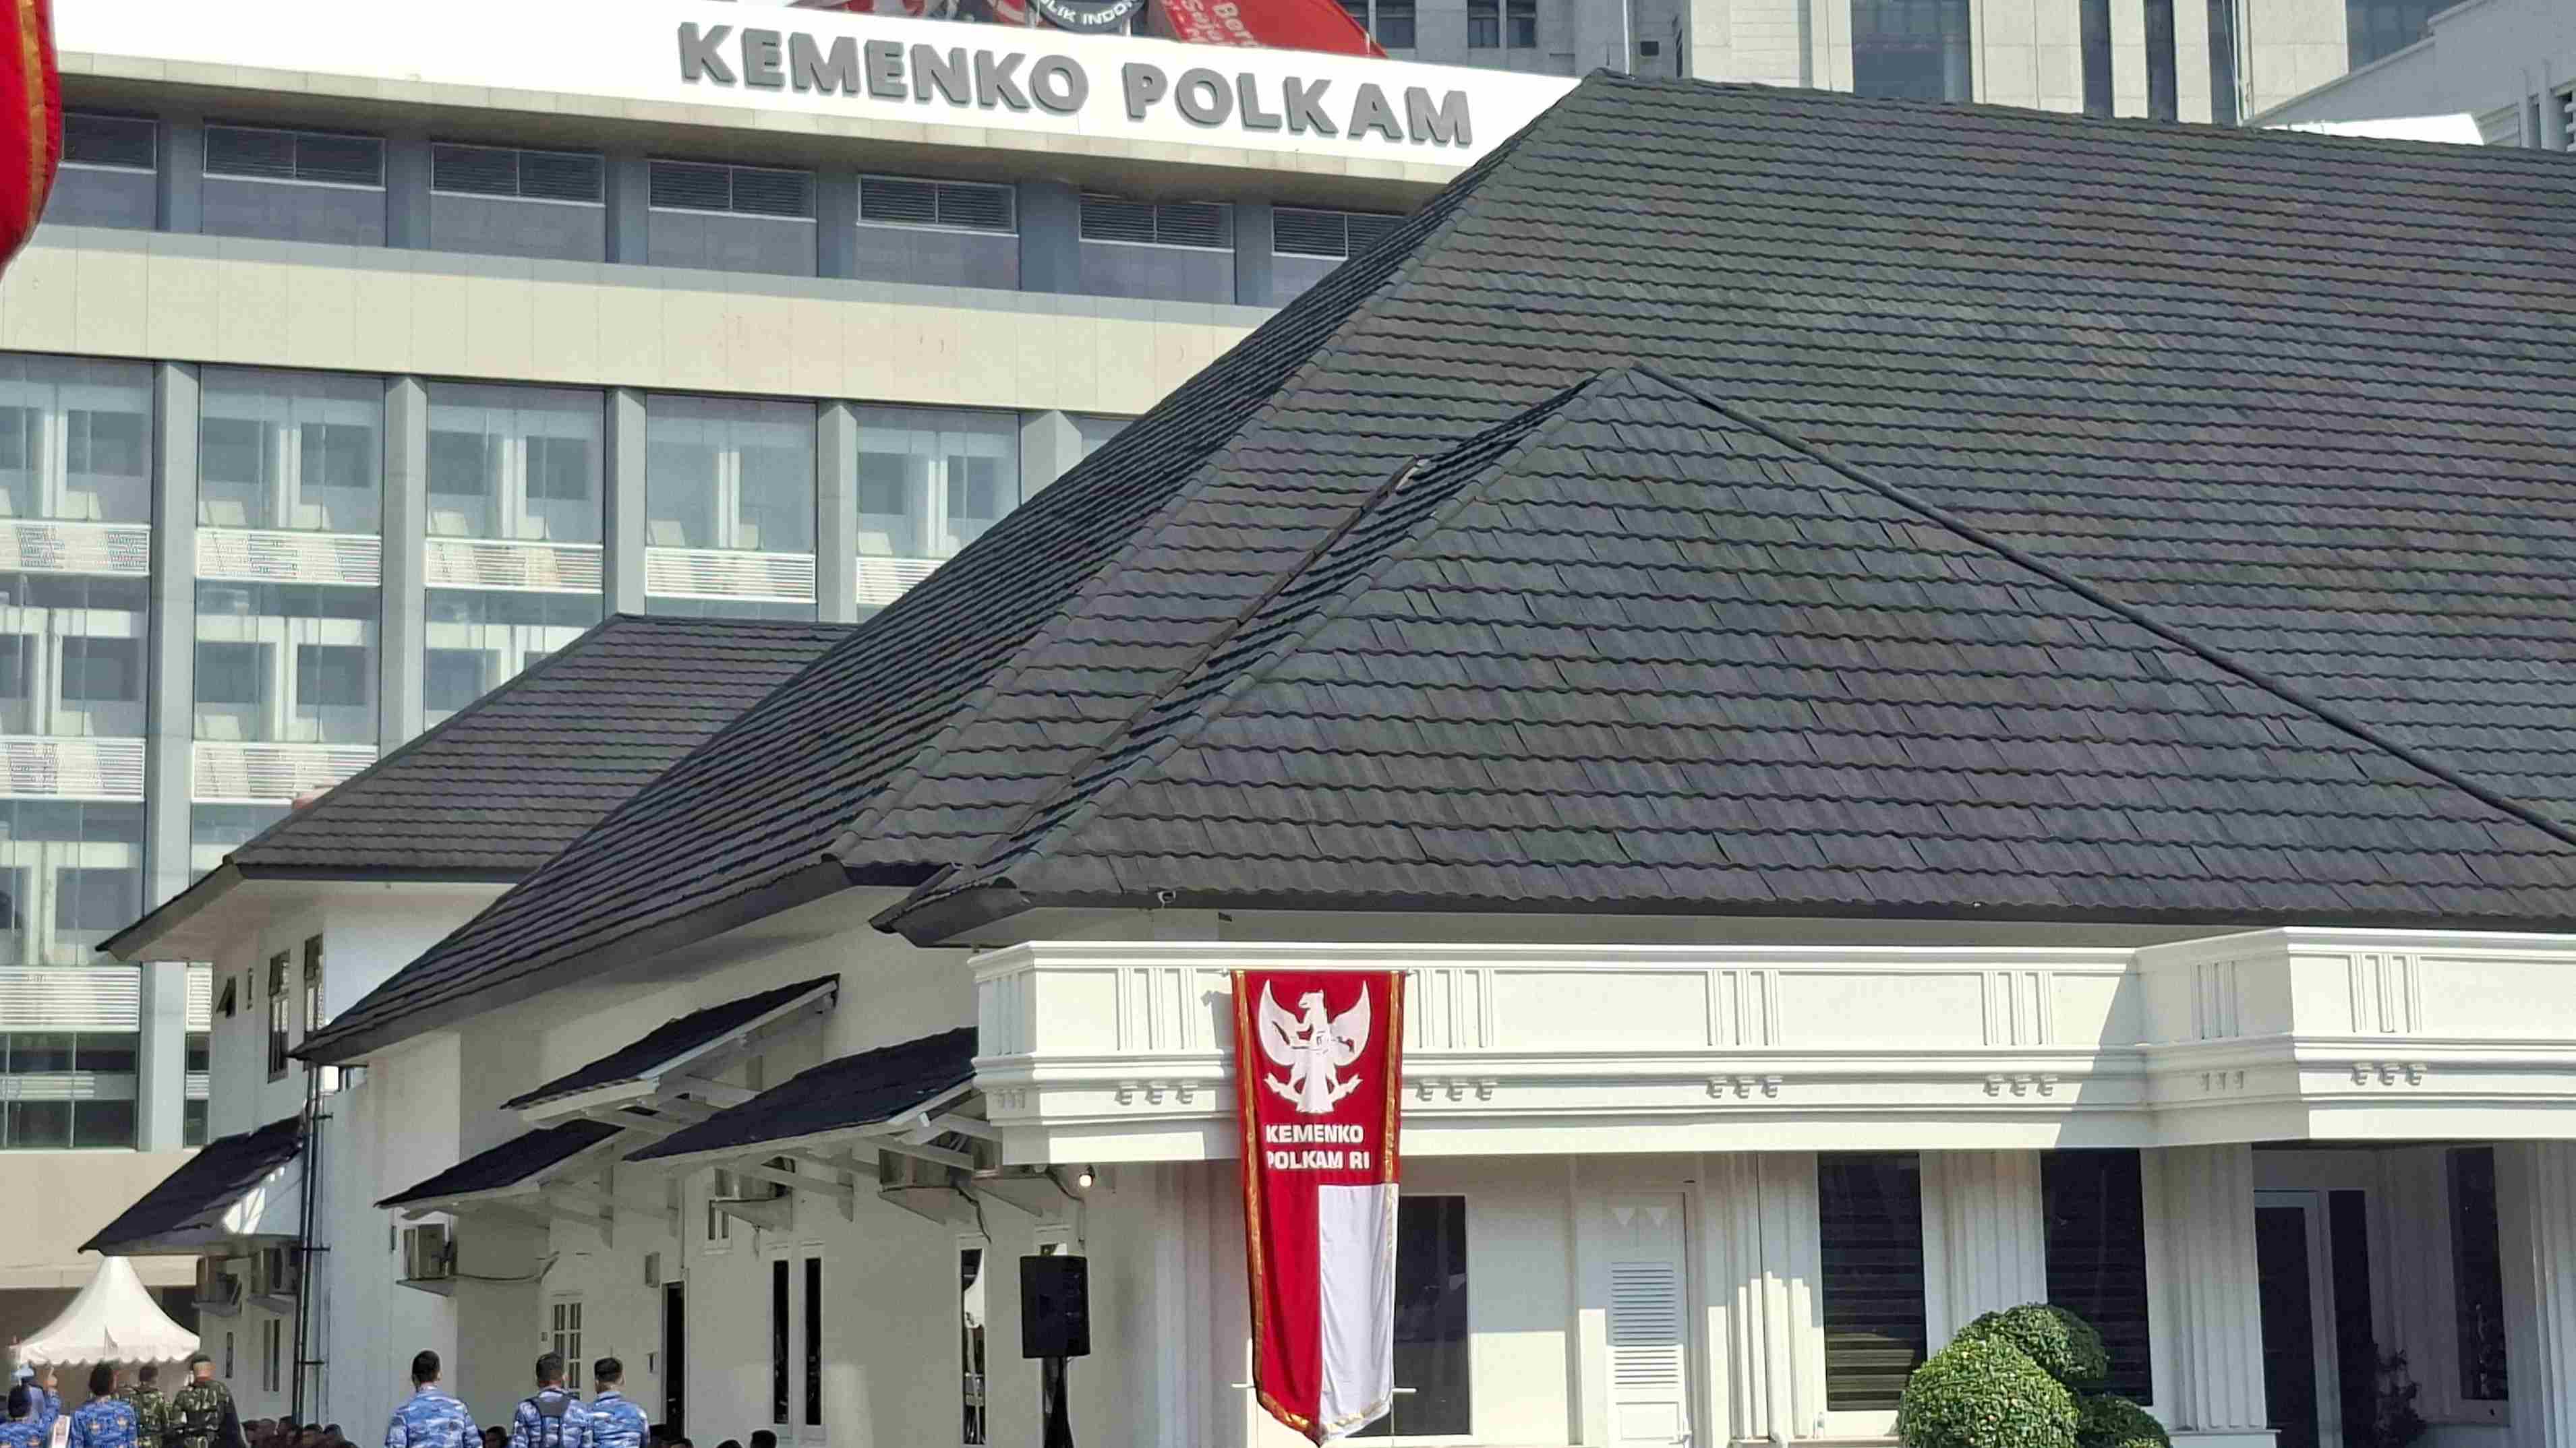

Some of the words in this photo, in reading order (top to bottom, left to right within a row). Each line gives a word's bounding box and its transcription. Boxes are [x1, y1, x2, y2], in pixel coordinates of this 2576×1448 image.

[678, 22, 1089, 115] KEMENKO
[1122, 61, 1473, 147] POLKAM
[1265, 1124, 1364, 1143] KEMENKO
[1349, 1151, 1370, 1170] RI
